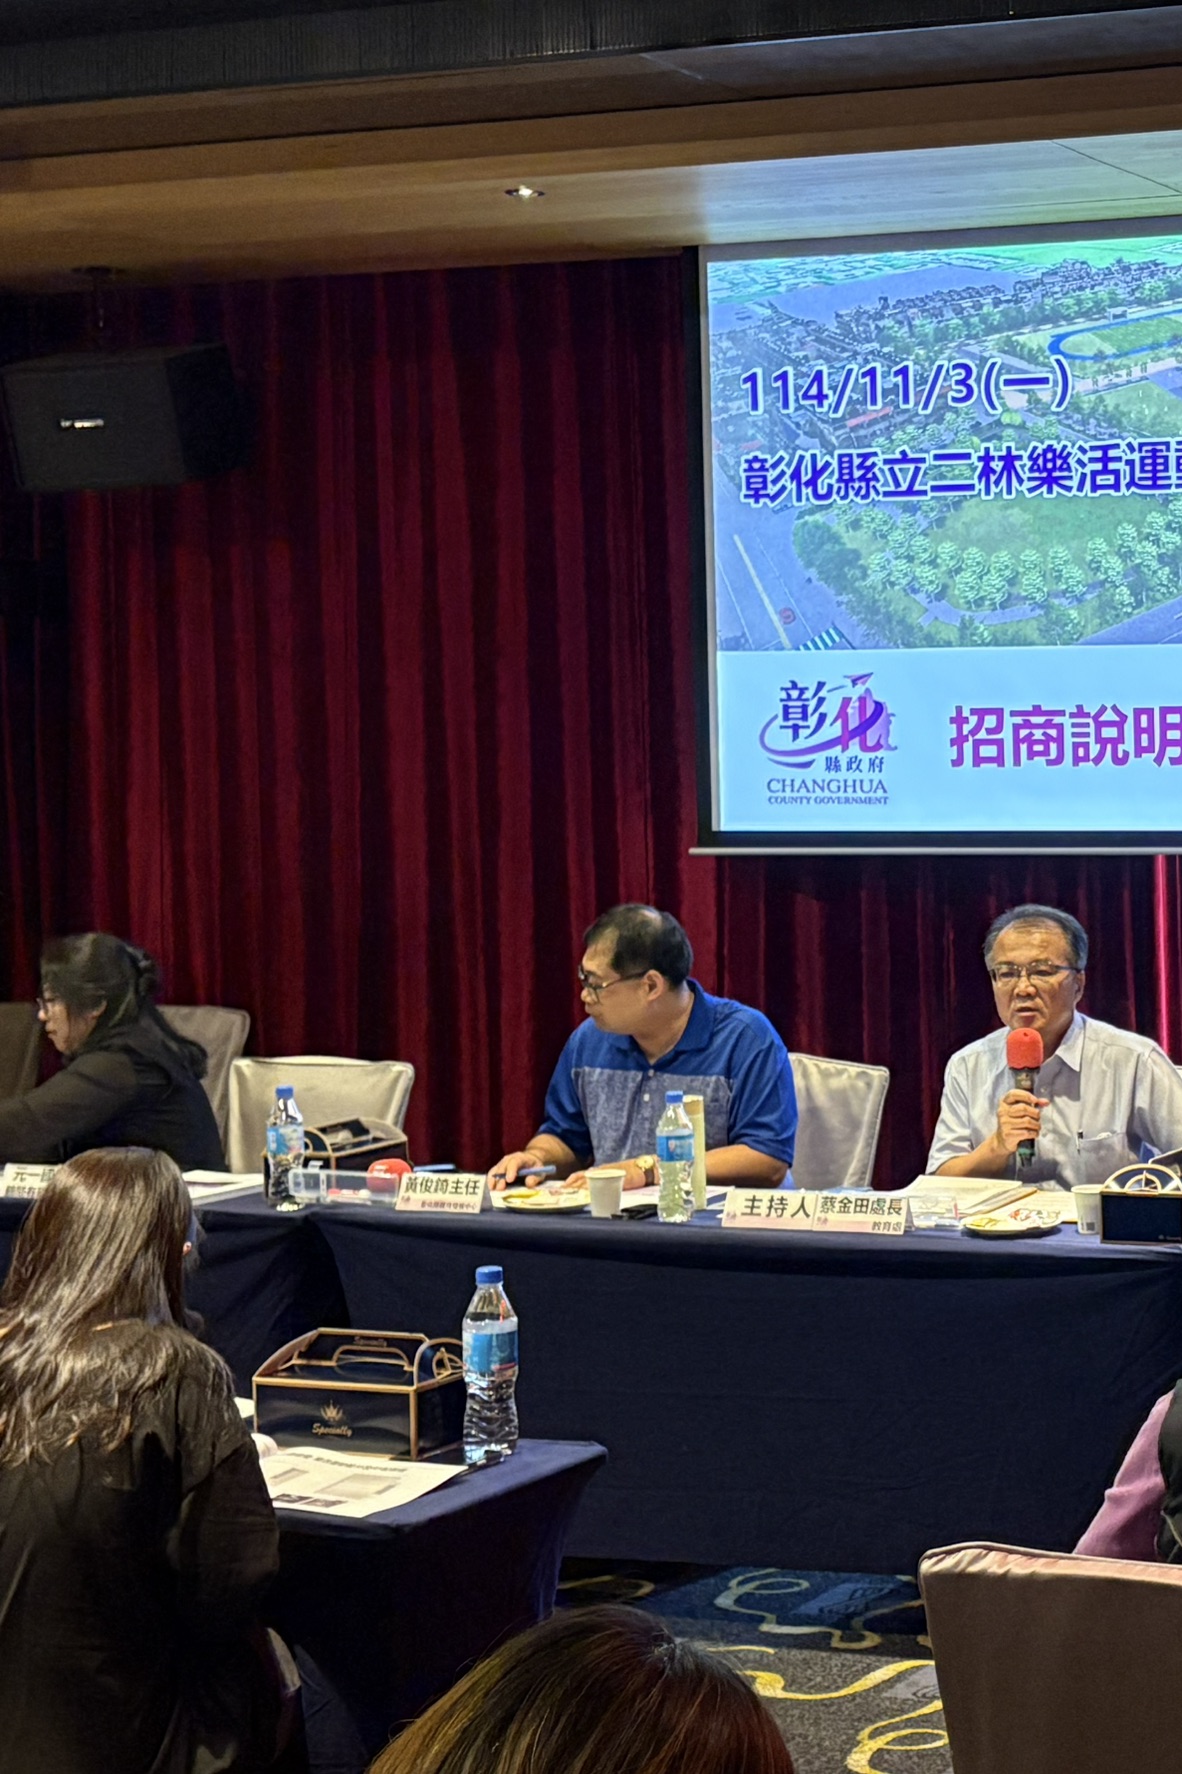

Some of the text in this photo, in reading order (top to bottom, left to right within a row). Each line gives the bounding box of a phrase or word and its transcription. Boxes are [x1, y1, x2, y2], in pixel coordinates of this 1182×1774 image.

[741, 357, 1073, 415] 114/11/3(一)
[825, 755, 885, 774] 縣政府
[767, 778, 888, 794] CHANGHUA
[768, 796, 889, 805] COUNTY GOVERNMENT
[741, 1195, 811, 1219] 主持人
[820, 1196, 903, 1216] 蔡金田處長
